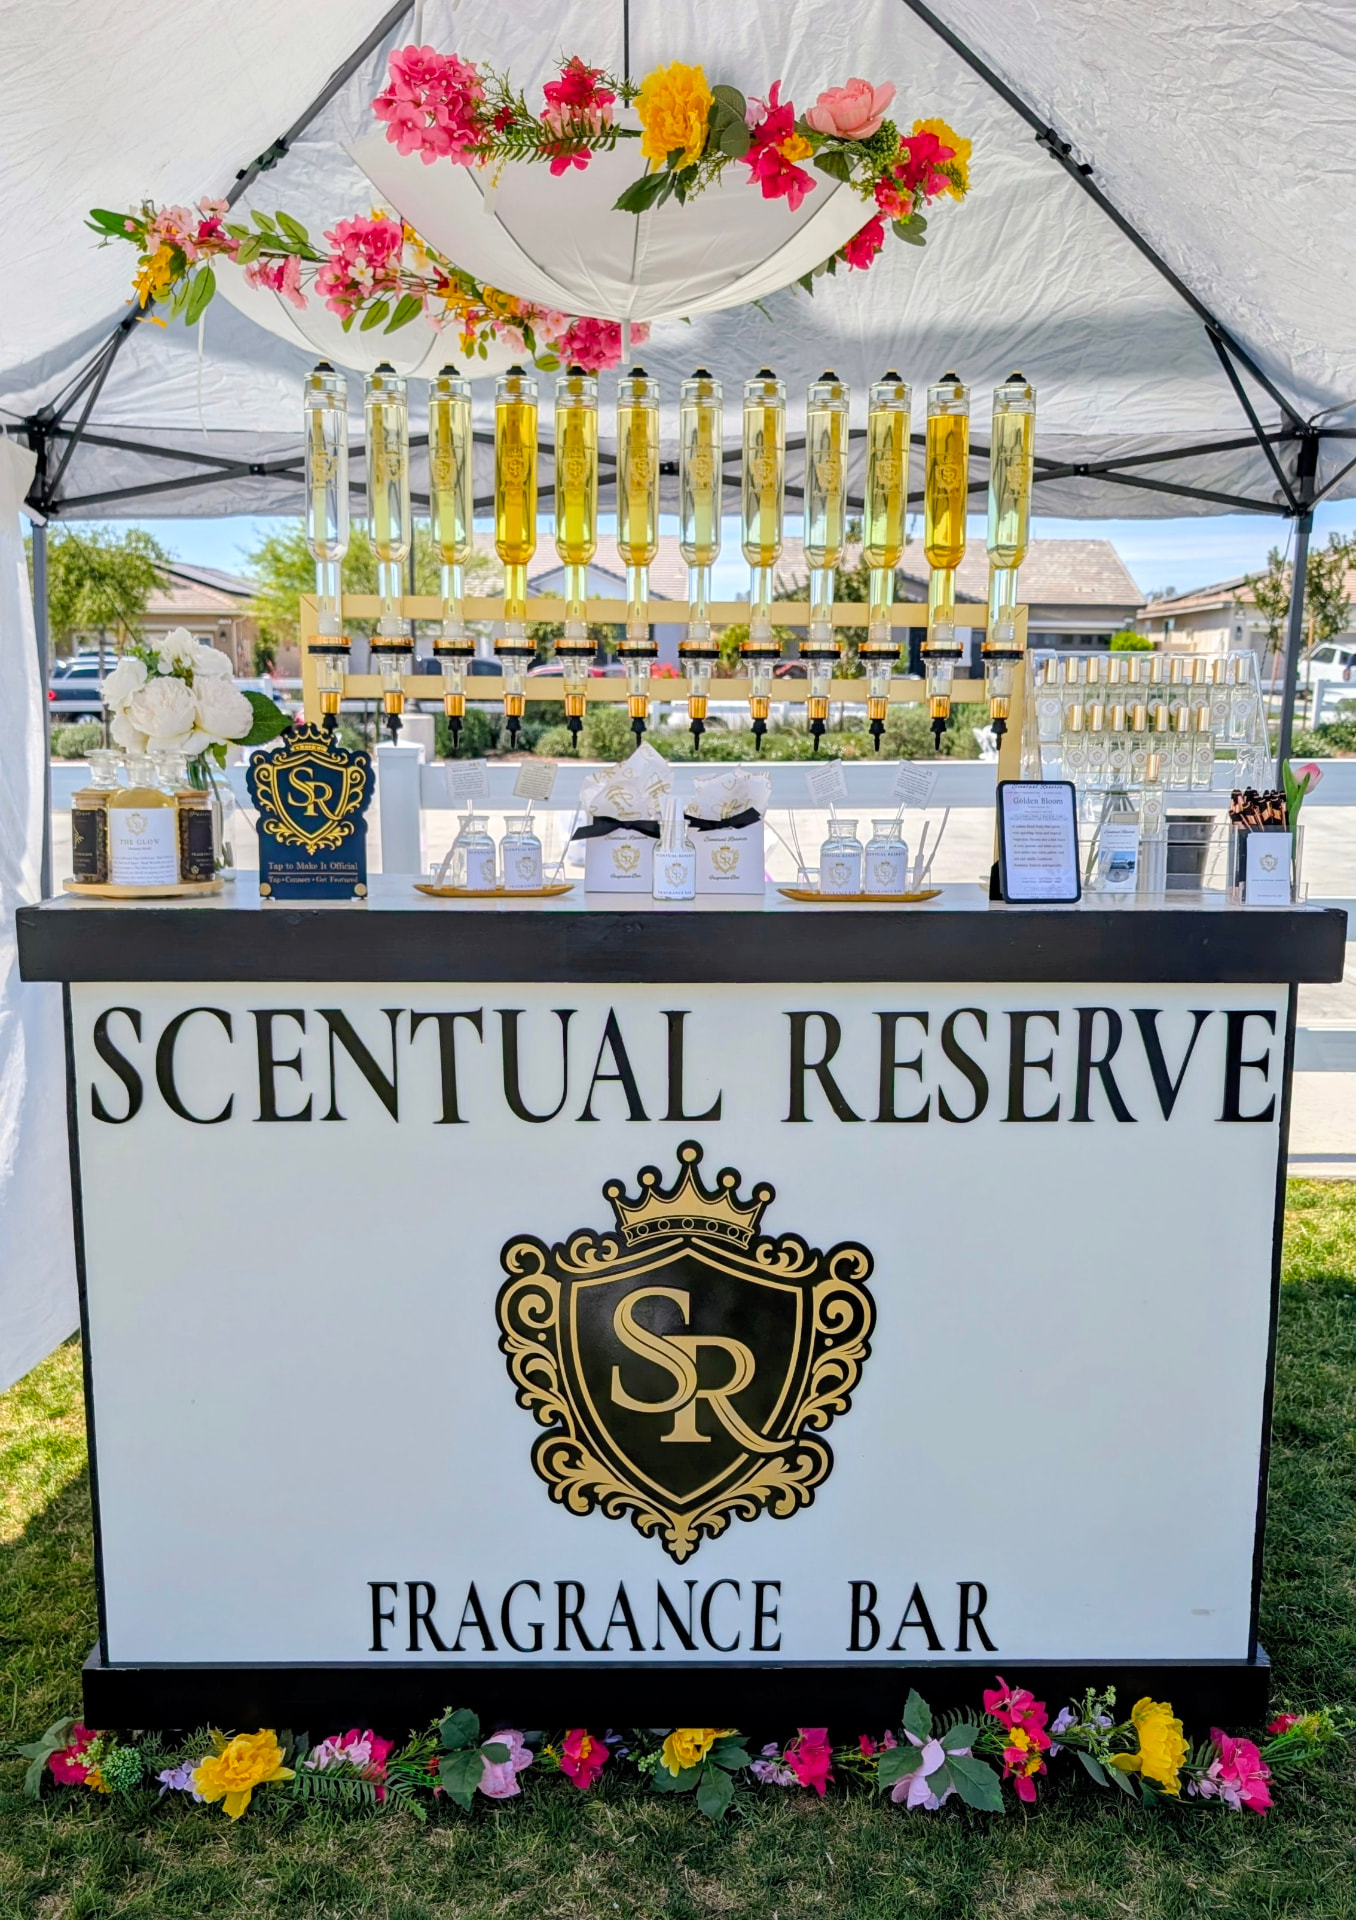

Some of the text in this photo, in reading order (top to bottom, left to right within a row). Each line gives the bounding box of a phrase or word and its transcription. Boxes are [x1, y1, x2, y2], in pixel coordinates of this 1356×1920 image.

[287, 766, 343, 820] SR
[1013, 797, 1063, 805] Golden Bloom
[268, 862, 358, 871] Tap to Make It Official
[91, 1006, 1277, 1124] SCENTUAL RESERVE
[610, 1286, 797, 1455] SR
[367, 1579, 999, 1653] FRAGRANCE BAR
